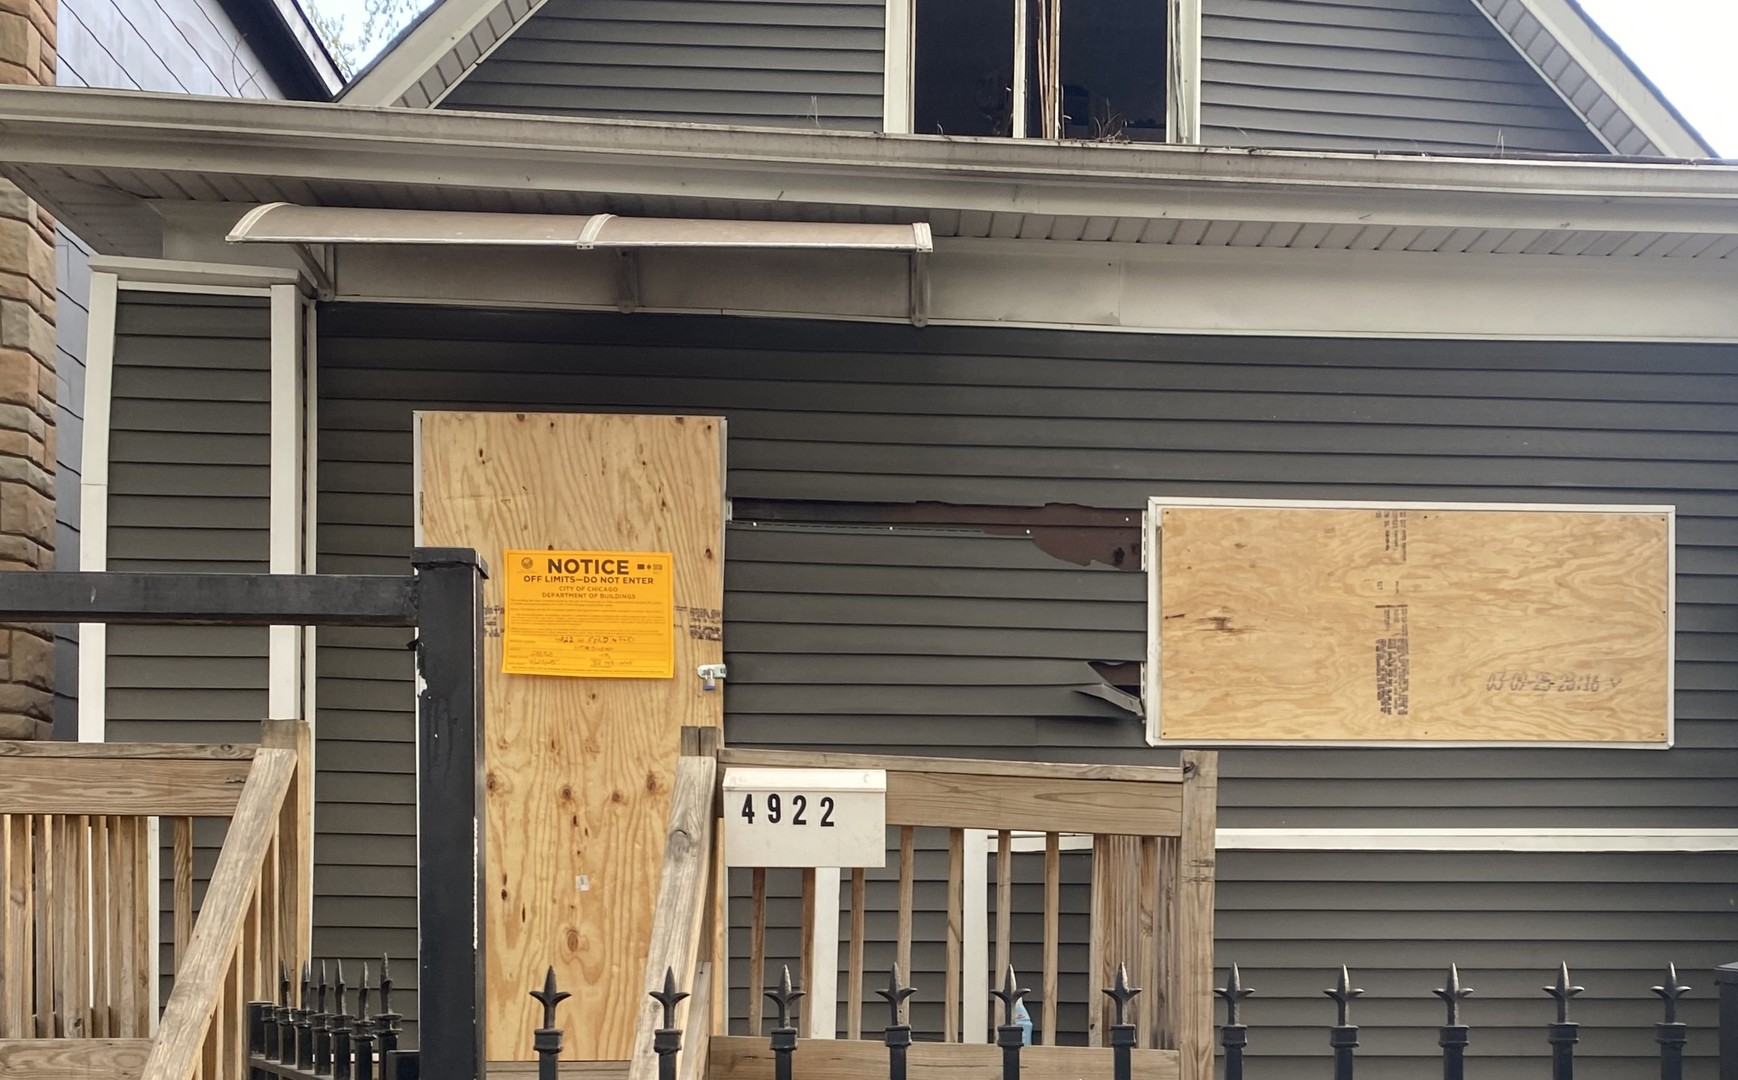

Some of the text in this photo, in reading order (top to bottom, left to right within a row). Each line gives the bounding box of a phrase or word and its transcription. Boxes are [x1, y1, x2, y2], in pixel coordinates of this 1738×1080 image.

[548, 559, 629, 575] NOTICE
[523, 575, 542, 583] OFF
[623, 577, 654, 585] ENTER
[741, 793, 835, 827] 4922
